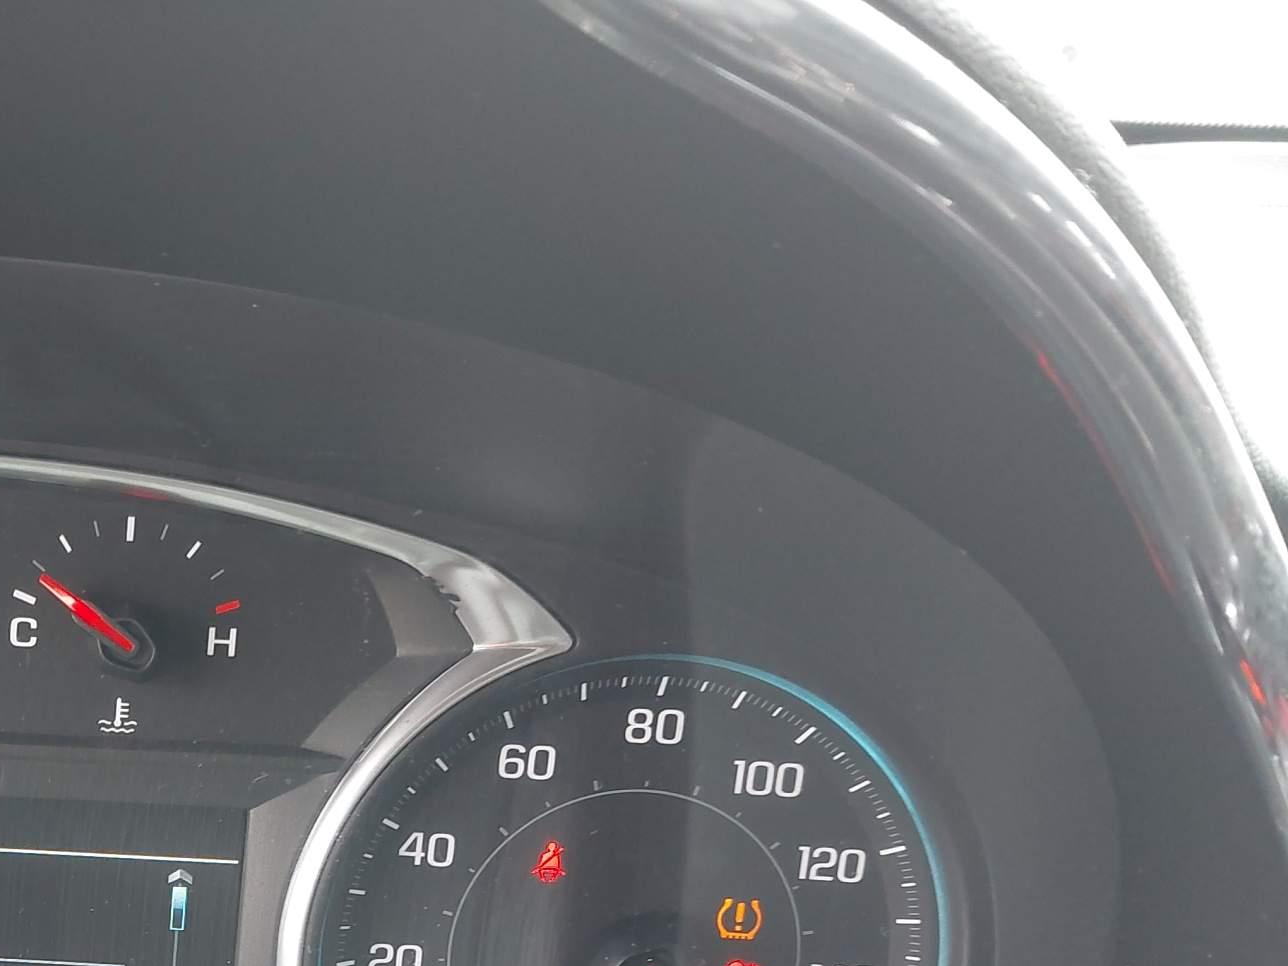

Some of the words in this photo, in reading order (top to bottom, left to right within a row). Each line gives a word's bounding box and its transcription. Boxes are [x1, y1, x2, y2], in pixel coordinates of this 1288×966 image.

[10, 616, 37, 648] C
[206, 626, 237, 657] H
[625, 708, 685, 745] 80
[498, 744, 556, 781] 60
[733, 760, 805, 798] 100
[398, 832, 455, 868] 40
[797, 846, 866, 884] 120
